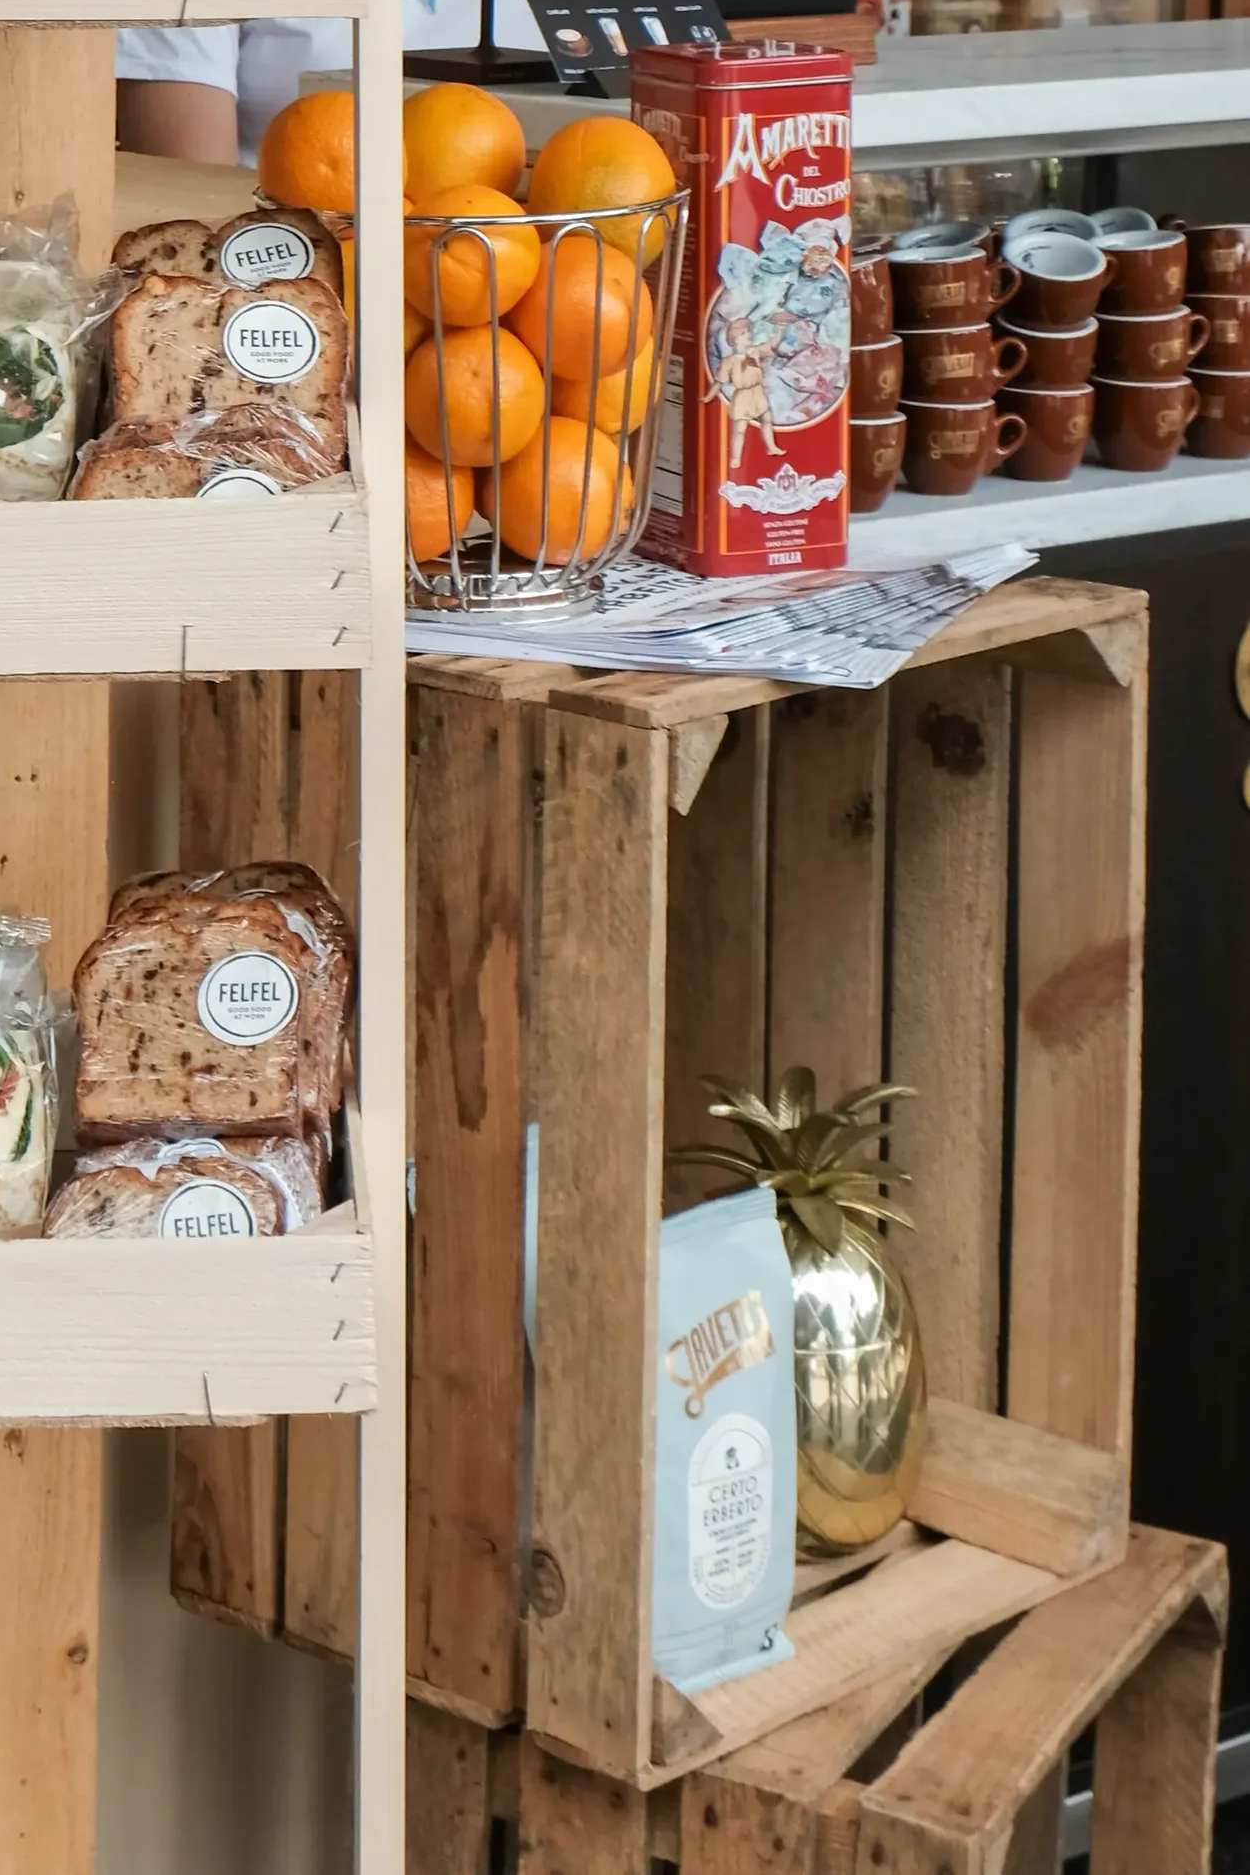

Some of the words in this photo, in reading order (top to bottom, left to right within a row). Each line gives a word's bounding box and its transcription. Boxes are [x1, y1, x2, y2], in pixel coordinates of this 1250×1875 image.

[234, 242, 298, 267] FELFEL
[239, 329, 303, 347] FELFEL
[219, 982, 281, 1003] FELFEL
[174, 1212, 240, 1238] FELFEL
[709, 1475, 758, 1504] CERTO
[703, 1493, 763, 1527] ERBERTO
